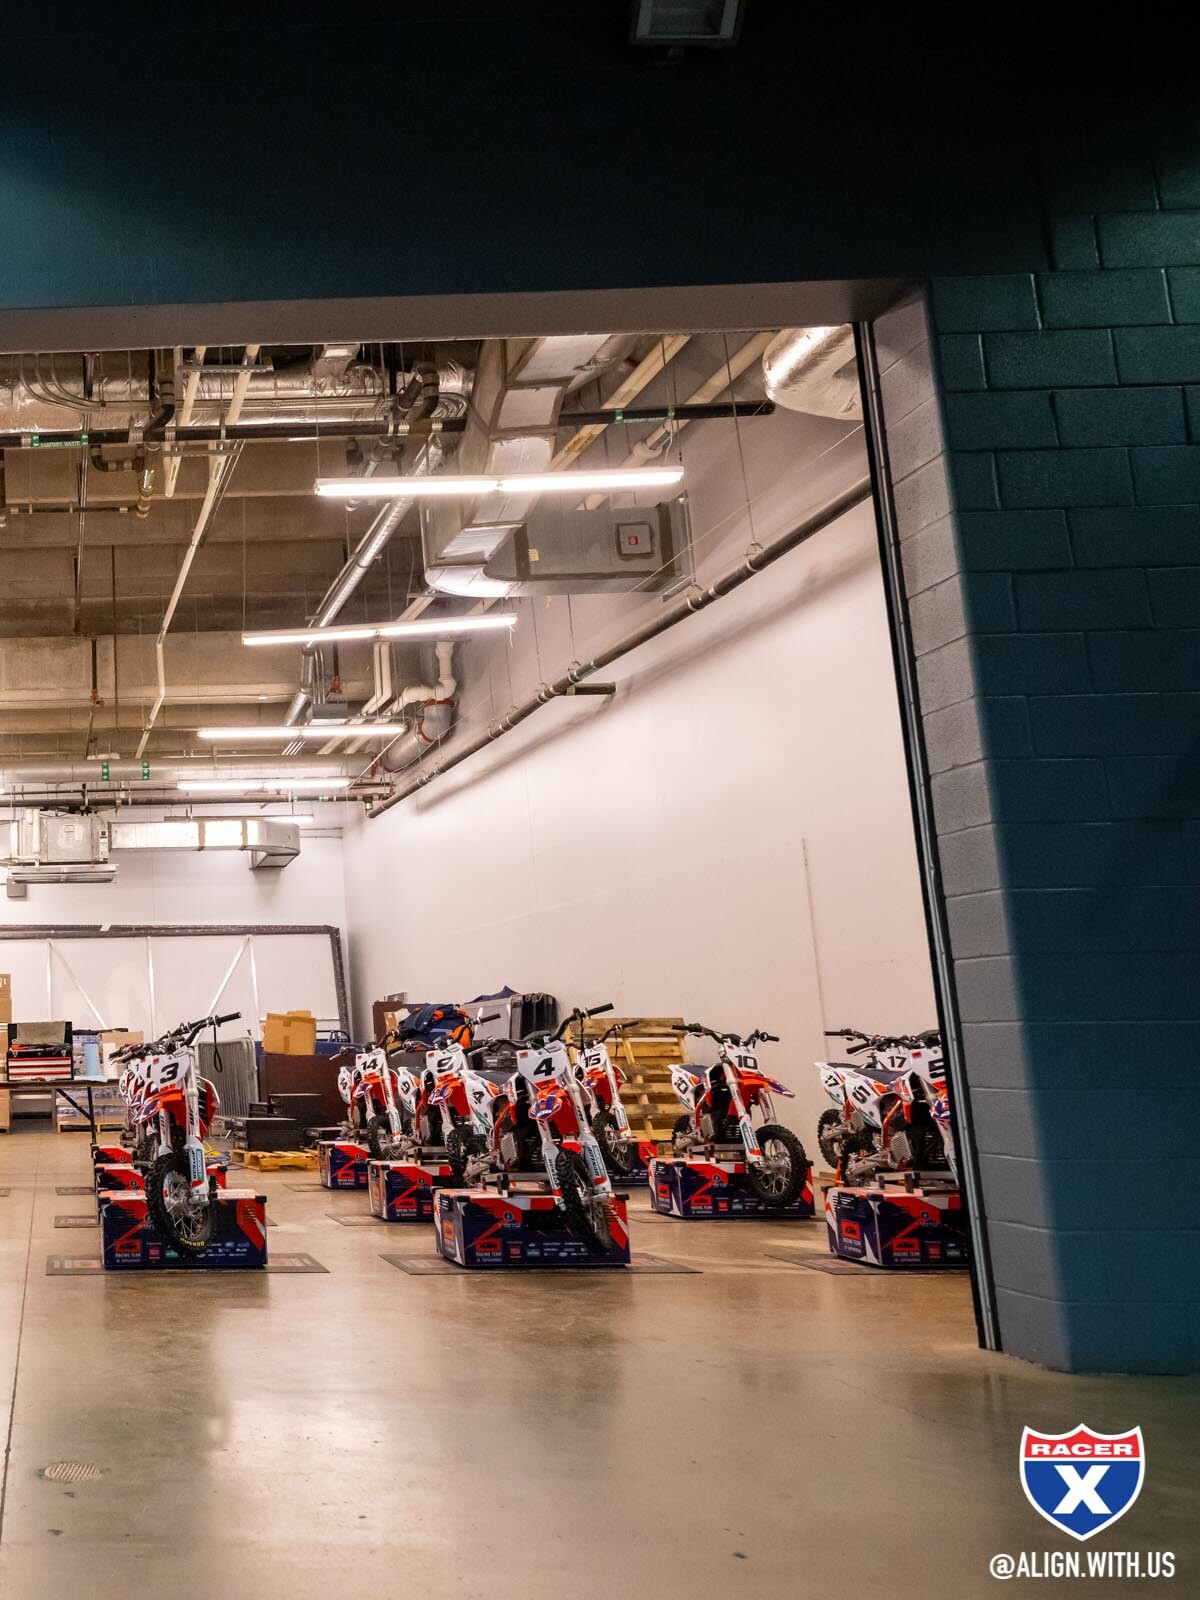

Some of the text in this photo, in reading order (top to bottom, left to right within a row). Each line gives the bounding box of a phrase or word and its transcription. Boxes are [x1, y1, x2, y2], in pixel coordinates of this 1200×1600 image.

[361, 1059, 378, 1071] 14
[534, 1057, 555, 1076] 4
[735, 1055, 758, 1070] 10
[887, 1056, 907, 1068] 17
[160, 1062, 179, 1084] 3
[825, 1075, 839, 1087] 17
[472, 1090, 485, 1104] 4
